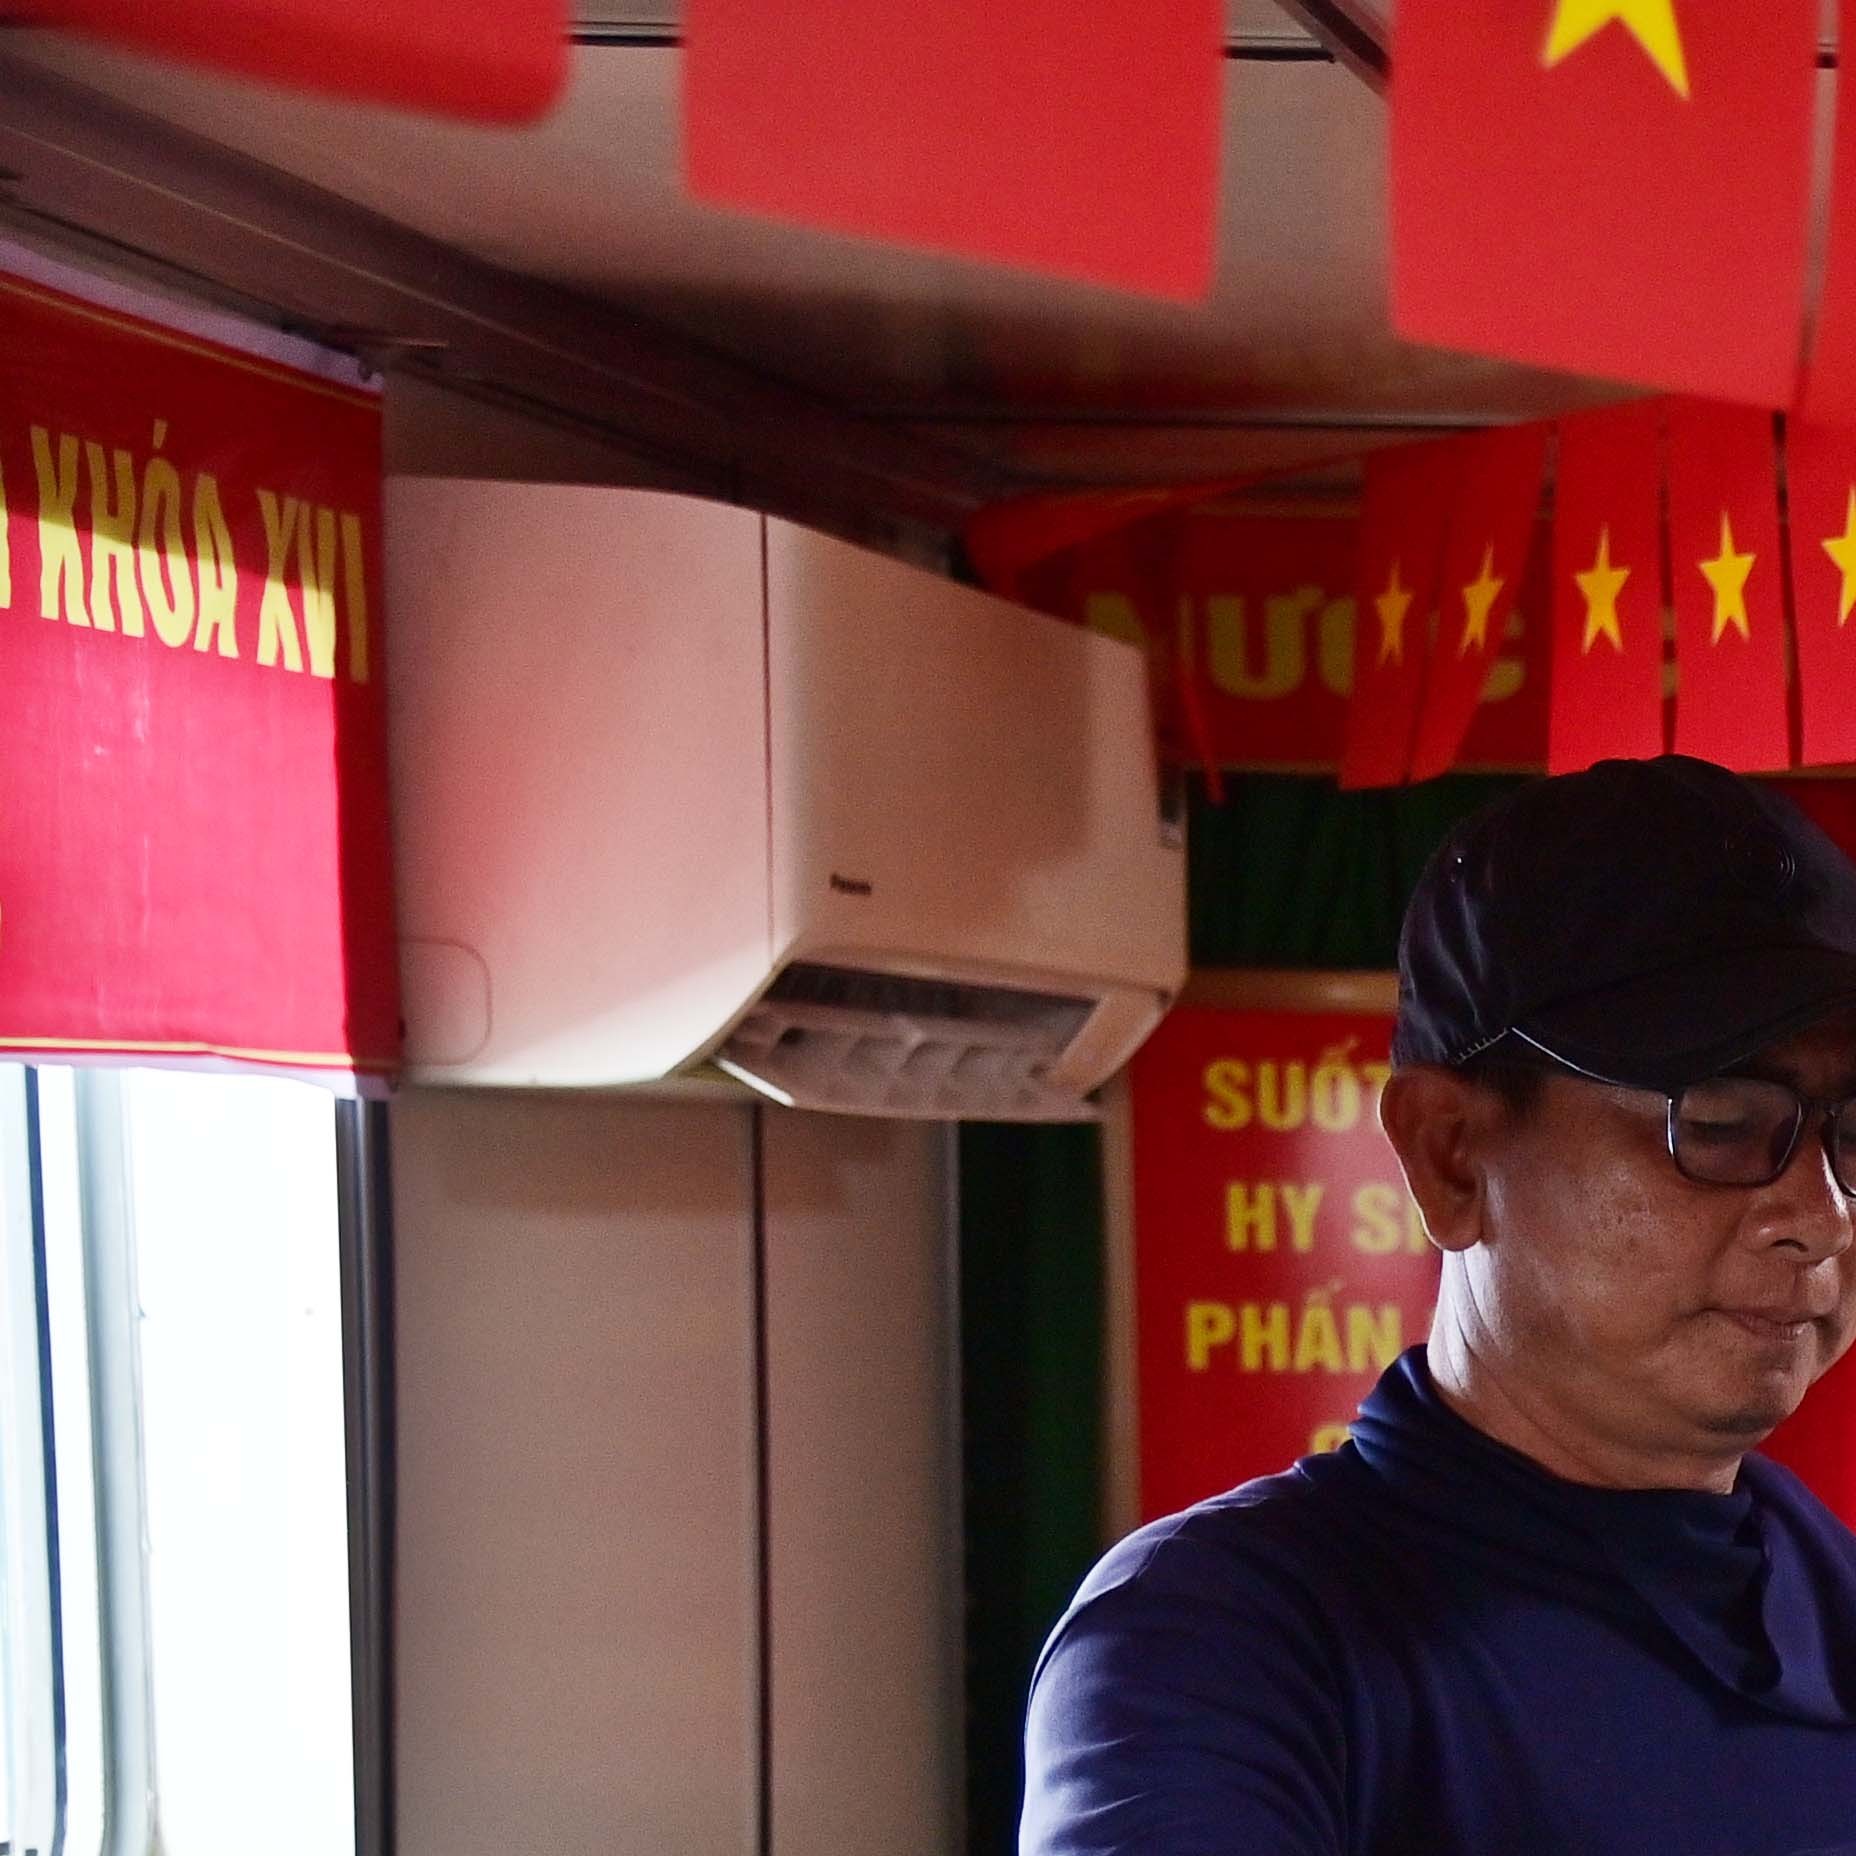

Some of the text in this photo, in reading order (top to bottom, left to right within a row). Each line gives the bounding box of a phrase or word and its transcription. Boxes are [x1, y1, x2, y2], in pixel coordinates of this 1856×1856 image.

[30, 418, 240, 658] KHÓA
[255, 487, 370, 685] XVI
[1204, 1036, 1393, 1131] SUỐ
[1225, 1182, 1324, 1252] HY
